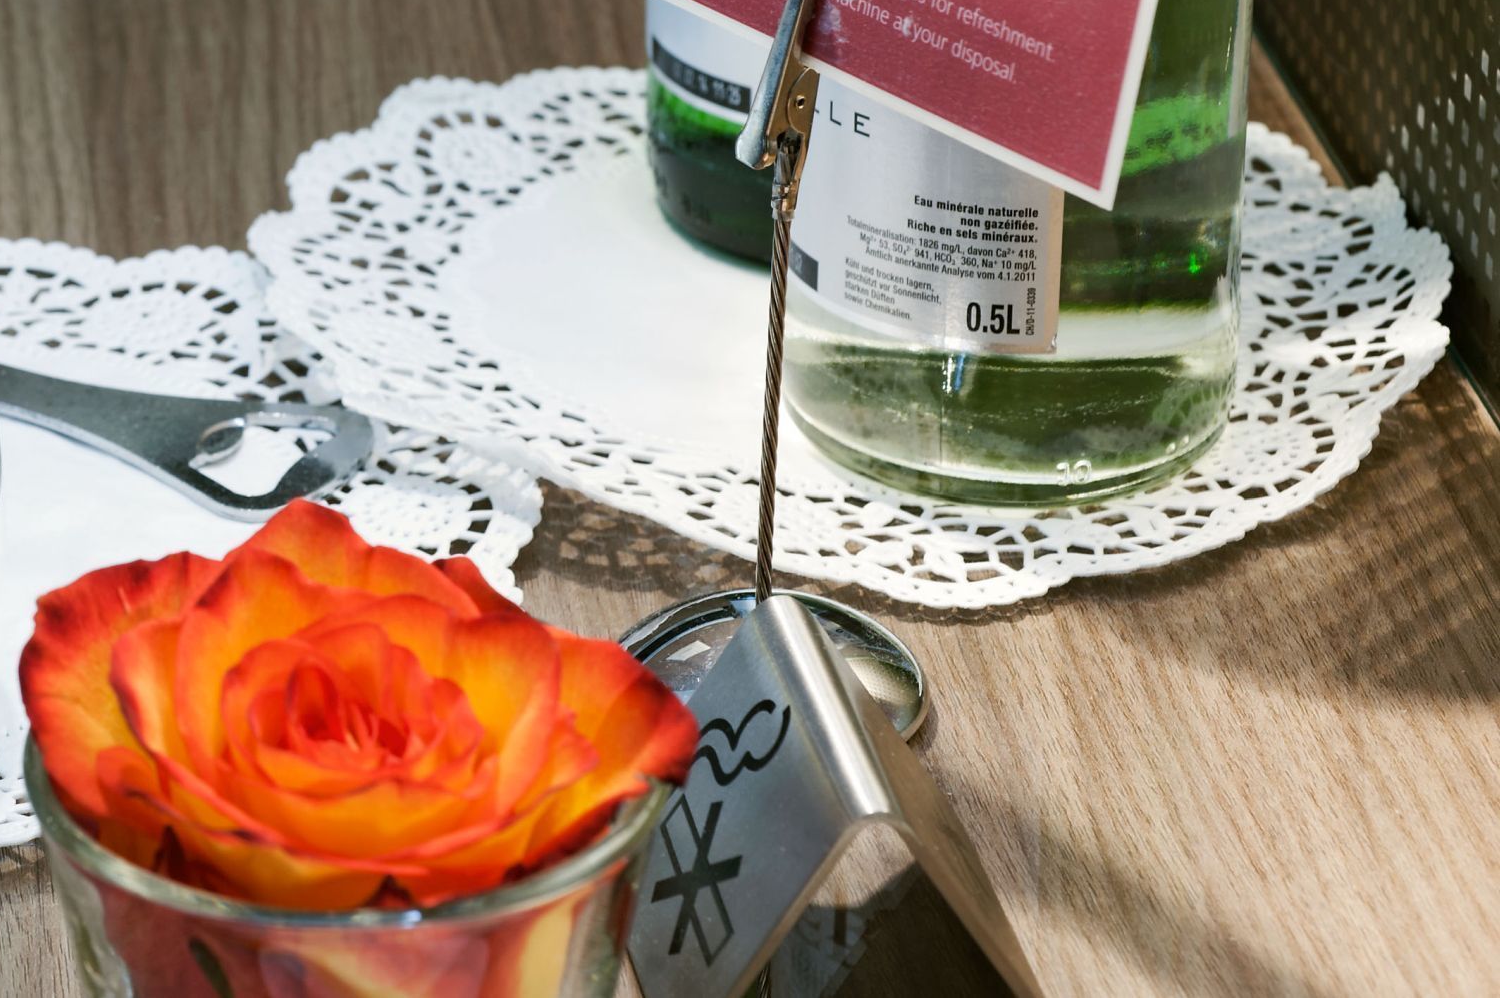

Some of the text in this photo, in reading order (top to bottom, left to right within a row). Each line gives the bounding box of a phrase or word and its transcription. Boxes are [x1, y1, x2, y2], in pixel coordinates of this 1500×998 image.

[956, 6, 1055, 63] refreshment.
[892, 15, 914, 37] at
[911, 23, 949, 51] your
[950, 38, 1016, 84] disposal.
[914, 194, 1039, 218] Eau minérale naturelle
[846, 214, 917, 246] Totalmineralisation:
[919, 237, 939, 250] 1826
[941, 243, 965, 255] mg/L,
[967, 245, 993, 257] davon
[1018, 249, 1037, 260] 418,
[907, 218, 1038, 244] Riche en sels minéraux.
[960, 217, 1038, 231] non gazéifiée.
[894, 256, 940, 274] anerkannte
[941, 264, 975, 279] Analyse
[977, 272, 996, 281] vom
[997, 272, 1036, 282] 4.1.2011
[960, 257, 980, 268] 360,
[1001, 260, 1012, 270] 10
[1014, 261, 1037, 272] mg/L
[876, 268, 905, 285] trocken
[906, 277, 935, 293] lagern,
[879, 282, 891, 292] vor
[892, 285, 942, 306] Sonnenlicht,
[966, 302, 1021, 335] 0.5L
